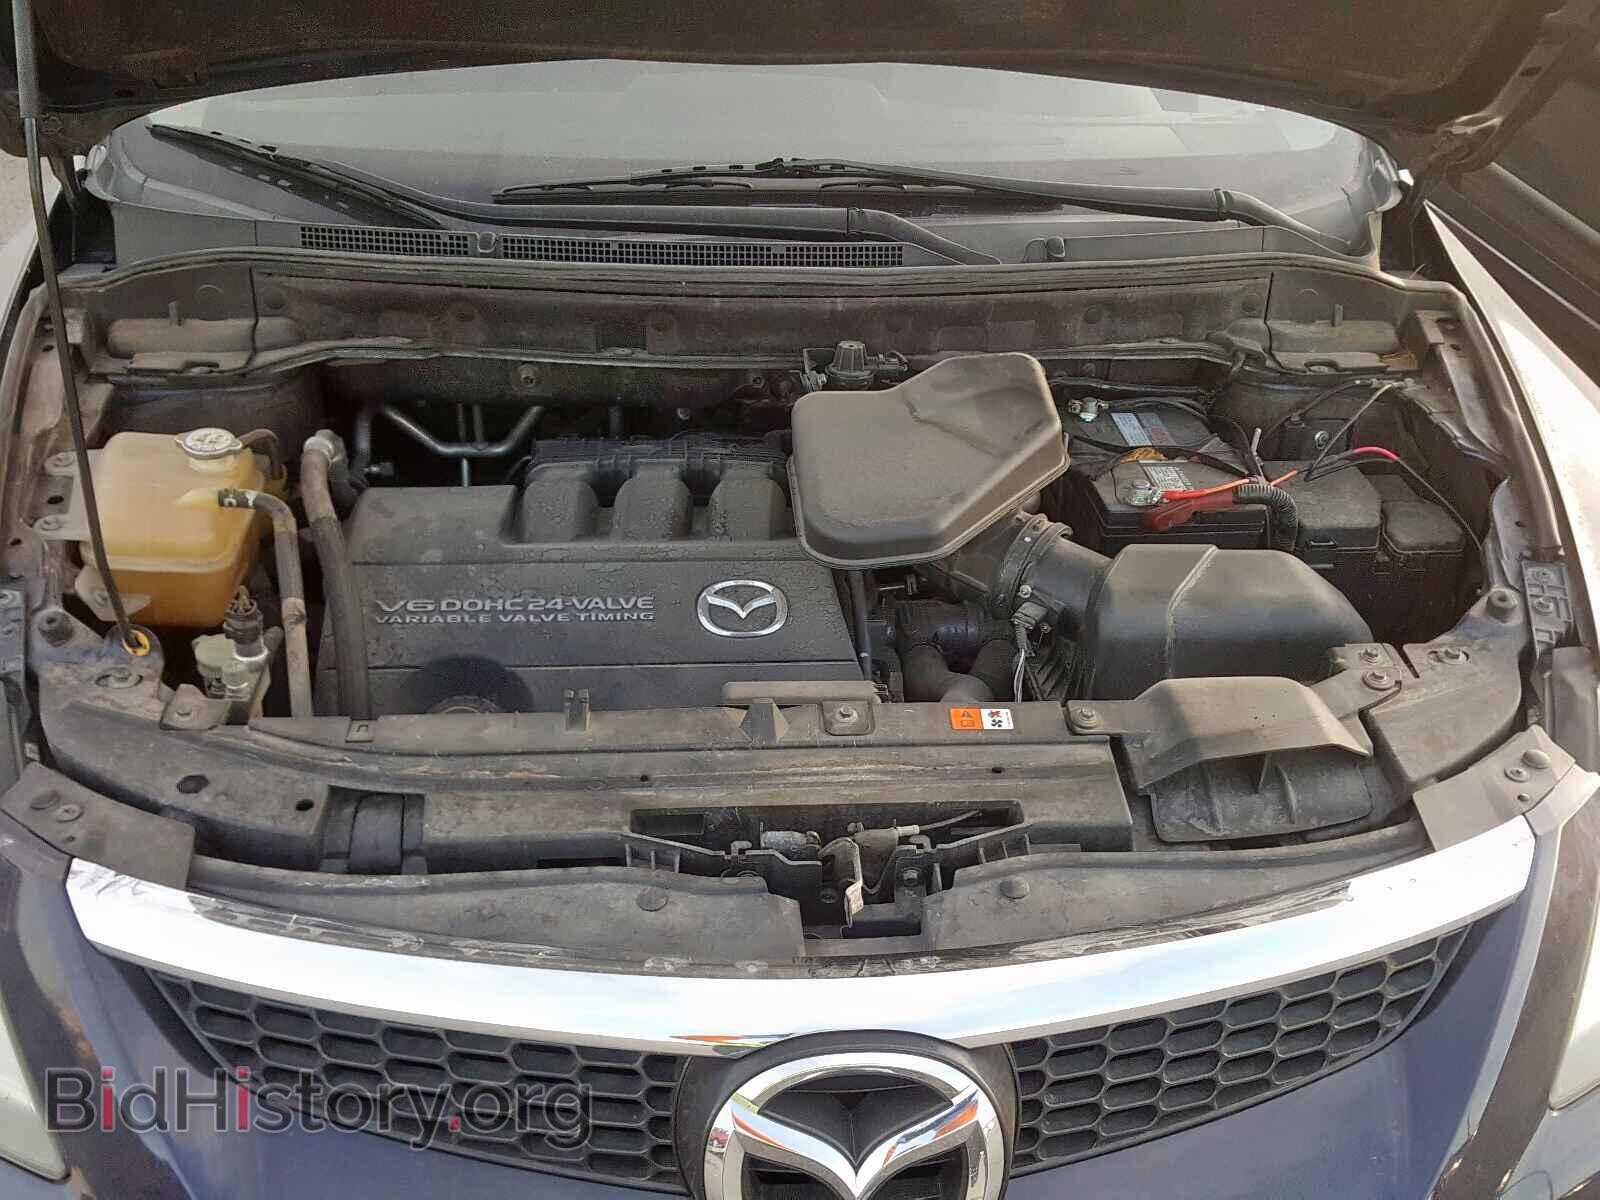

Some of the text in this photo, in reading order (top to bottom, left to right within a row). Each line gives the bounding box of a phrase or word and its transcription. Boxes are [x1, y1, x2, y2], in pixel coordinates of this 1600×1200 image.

[376, 596, 654, 612] V6 DOHC 24-VALVE
[375, 611, 654, 623] VARIABLE VALVE TIMING
